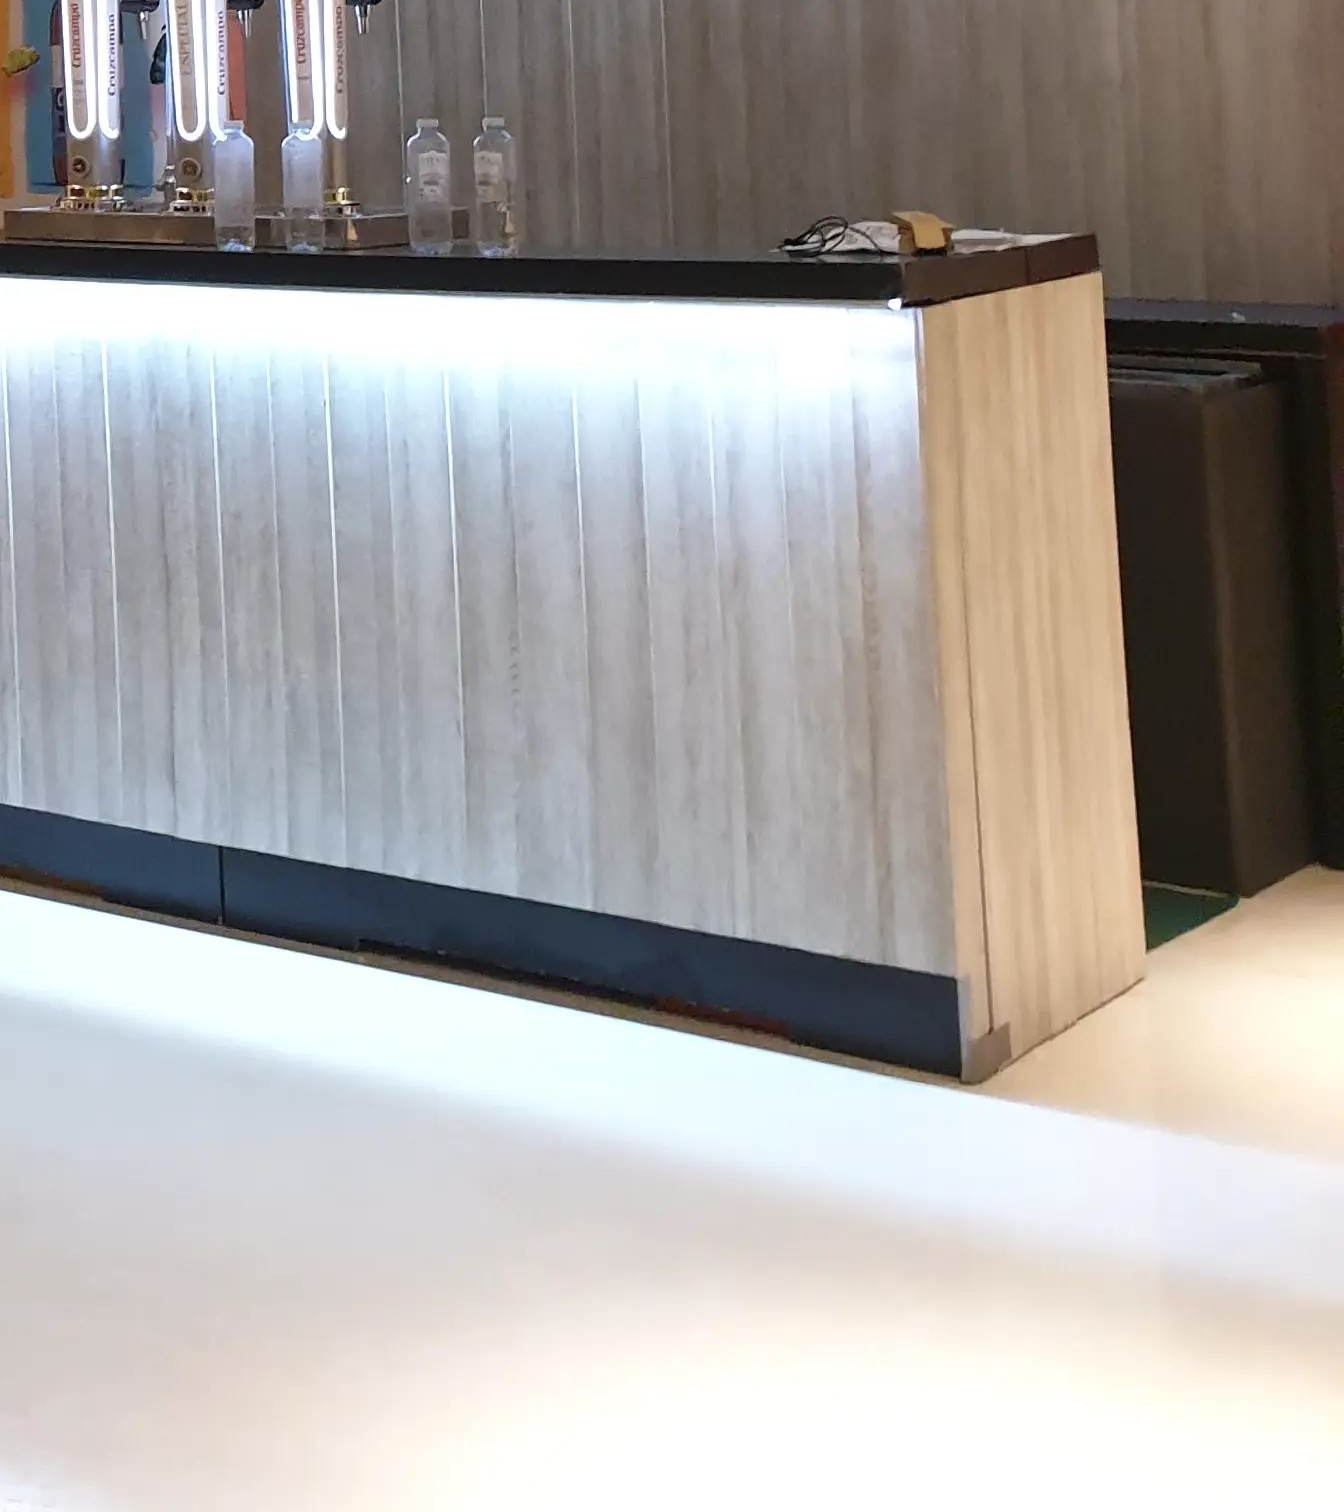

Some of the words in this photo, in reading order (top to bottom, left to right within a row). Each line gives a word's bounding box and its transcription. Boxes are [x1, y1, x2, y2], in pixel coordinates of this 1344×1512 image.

[107, 14, 116, 97] Cruzcampo
[217, 9, 227, 96] Cruzcampo
[334, 5, 343, 94] Cruzcampo
